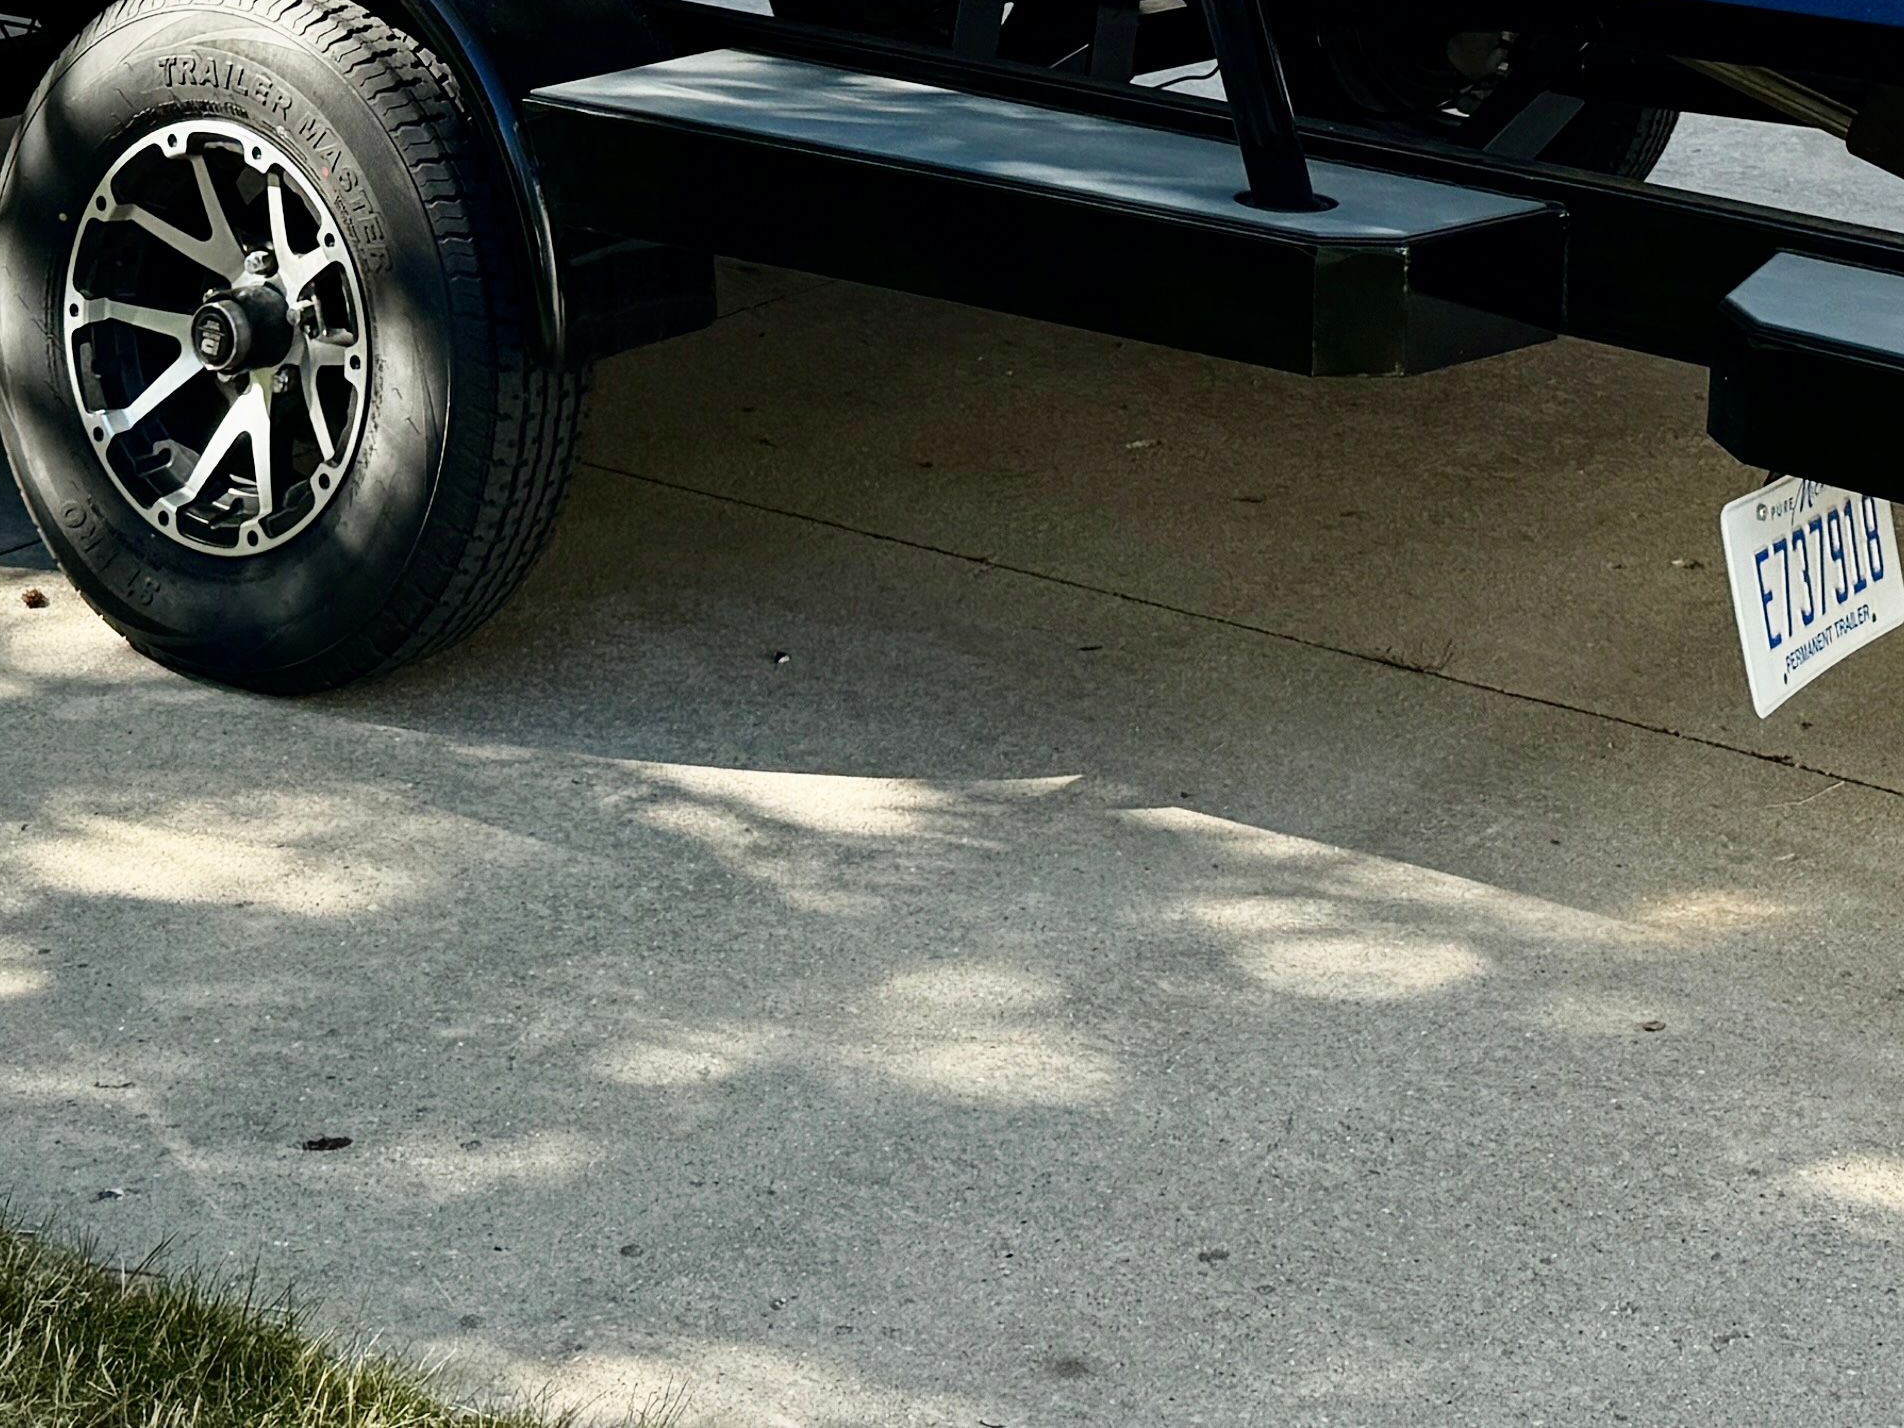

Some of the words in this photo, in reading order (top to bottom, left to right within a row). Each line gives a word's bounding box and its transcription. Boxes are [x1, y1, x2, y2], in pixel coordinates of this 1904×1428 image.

[158, 55, 293, 122] TRAILER
[298, 111, 393, 275] MASTER
[1770, 497, 1794, 521] PURE
[1754, 495, 1885, 651] E737918
[1784, 624, 1833, 674] PERMANENT
[1834, 604, 1871, 642] TRAILER
